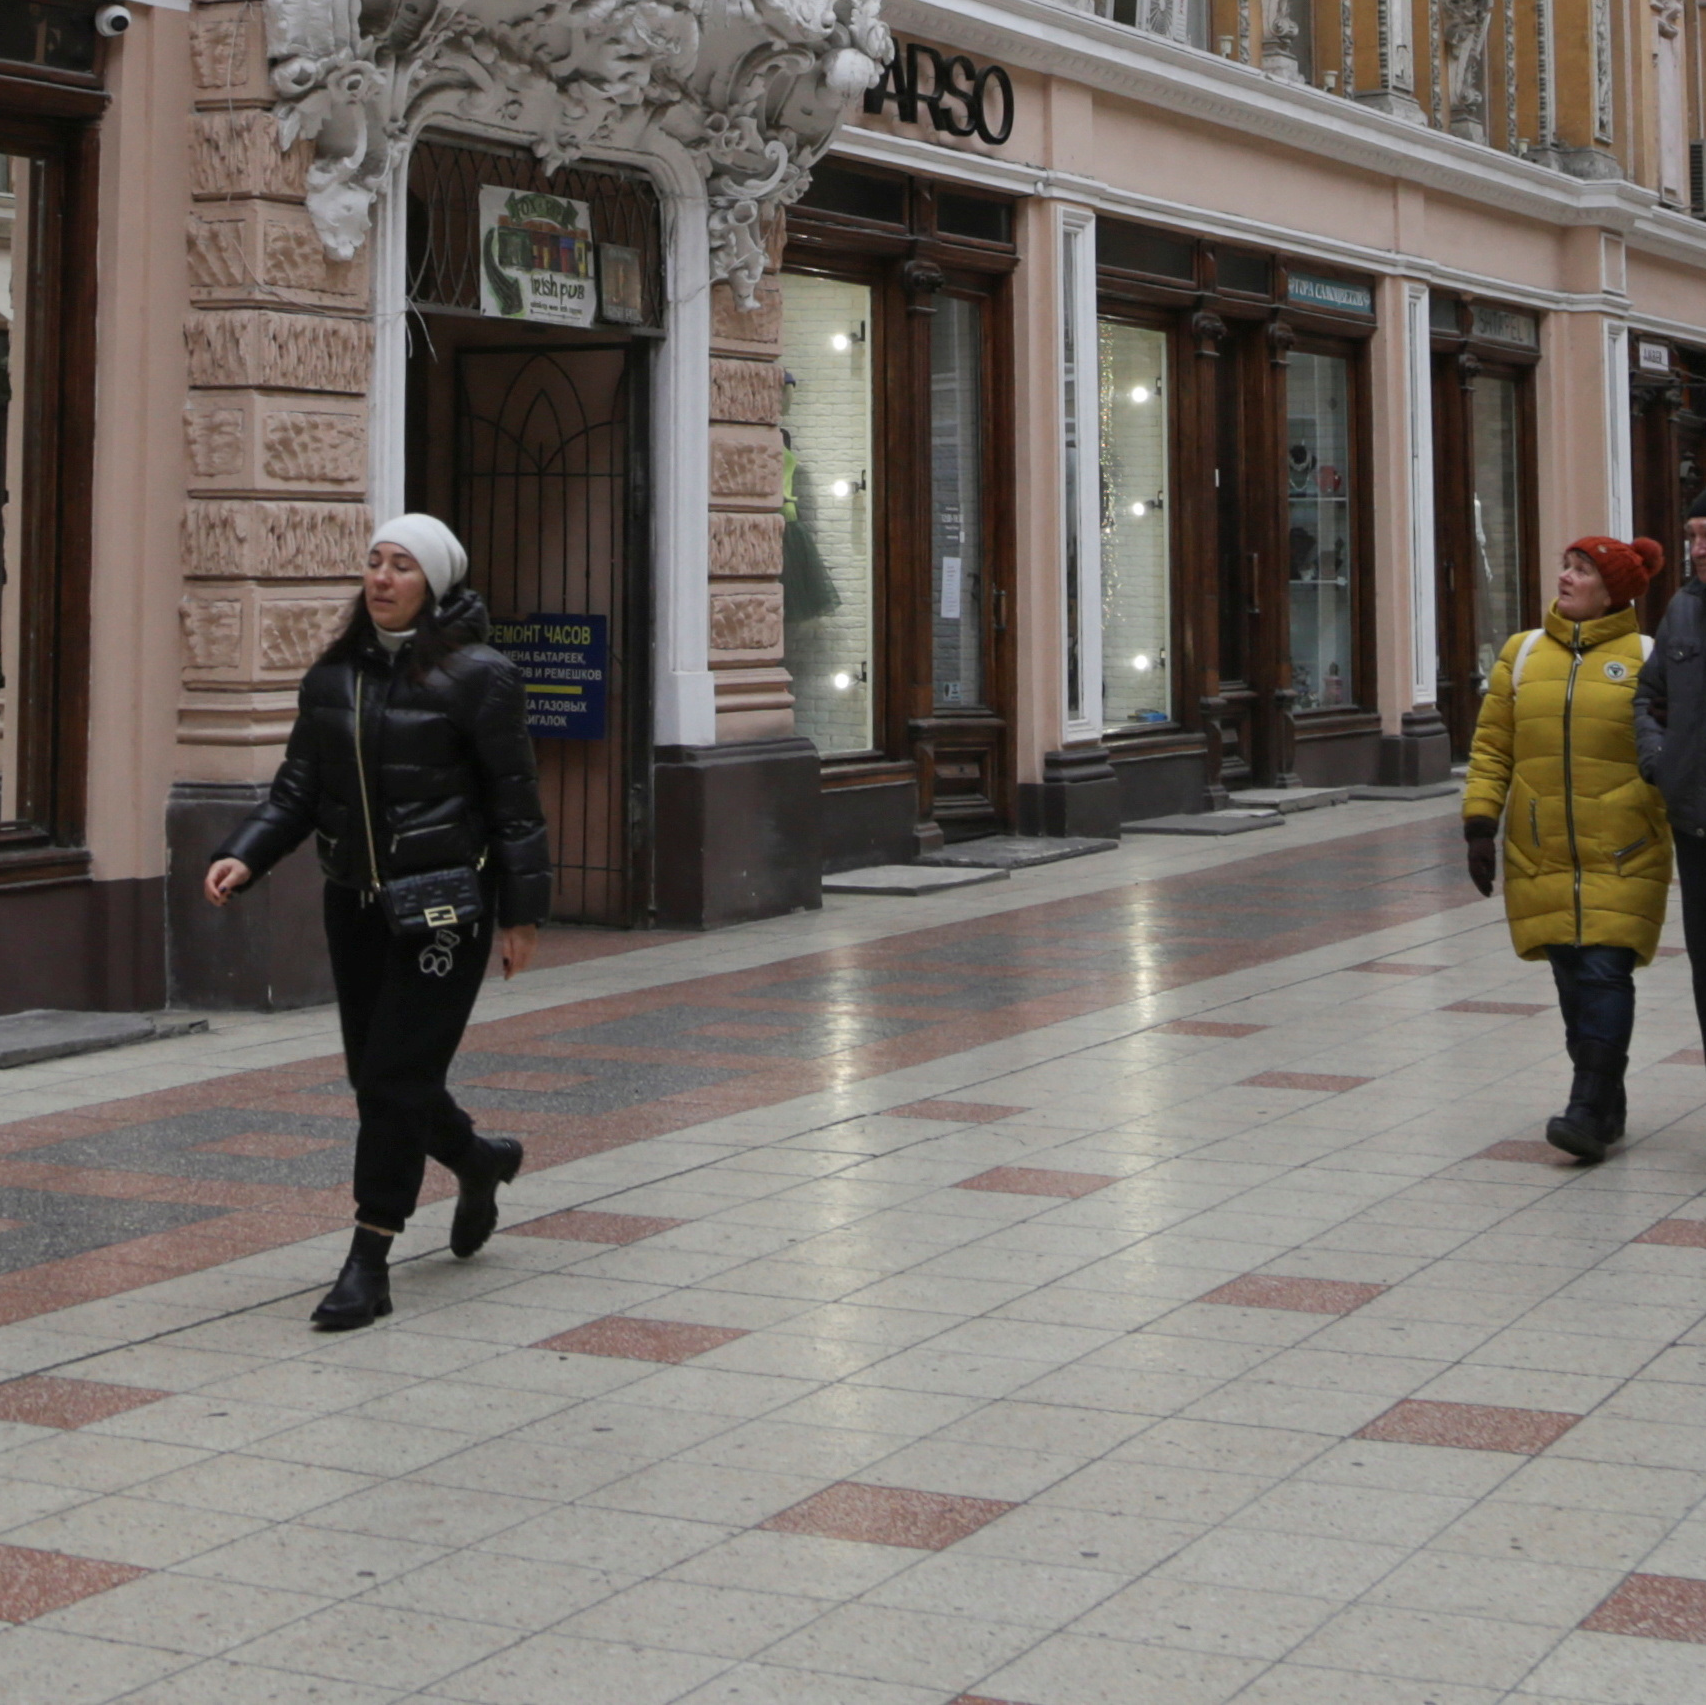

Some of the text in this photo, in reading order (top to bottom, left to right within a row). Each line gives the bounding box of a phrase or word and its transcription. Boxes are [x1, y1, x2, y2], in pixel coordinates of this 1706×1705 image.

[863, 36, 1015, 145] ARSO
[489, 624, 592, 645] РЕМОНТ ЧАСОВ
[533, 651, 587, 665] БАТАРЕЕК,
[534, 668, 543, 678] И
[544, 668, 603, 681] РЕМЕШКОВ
[539, 700, 588, 713] ГАЗОВЫХ
[525, 715, 568, 728] ИГАЛОК
